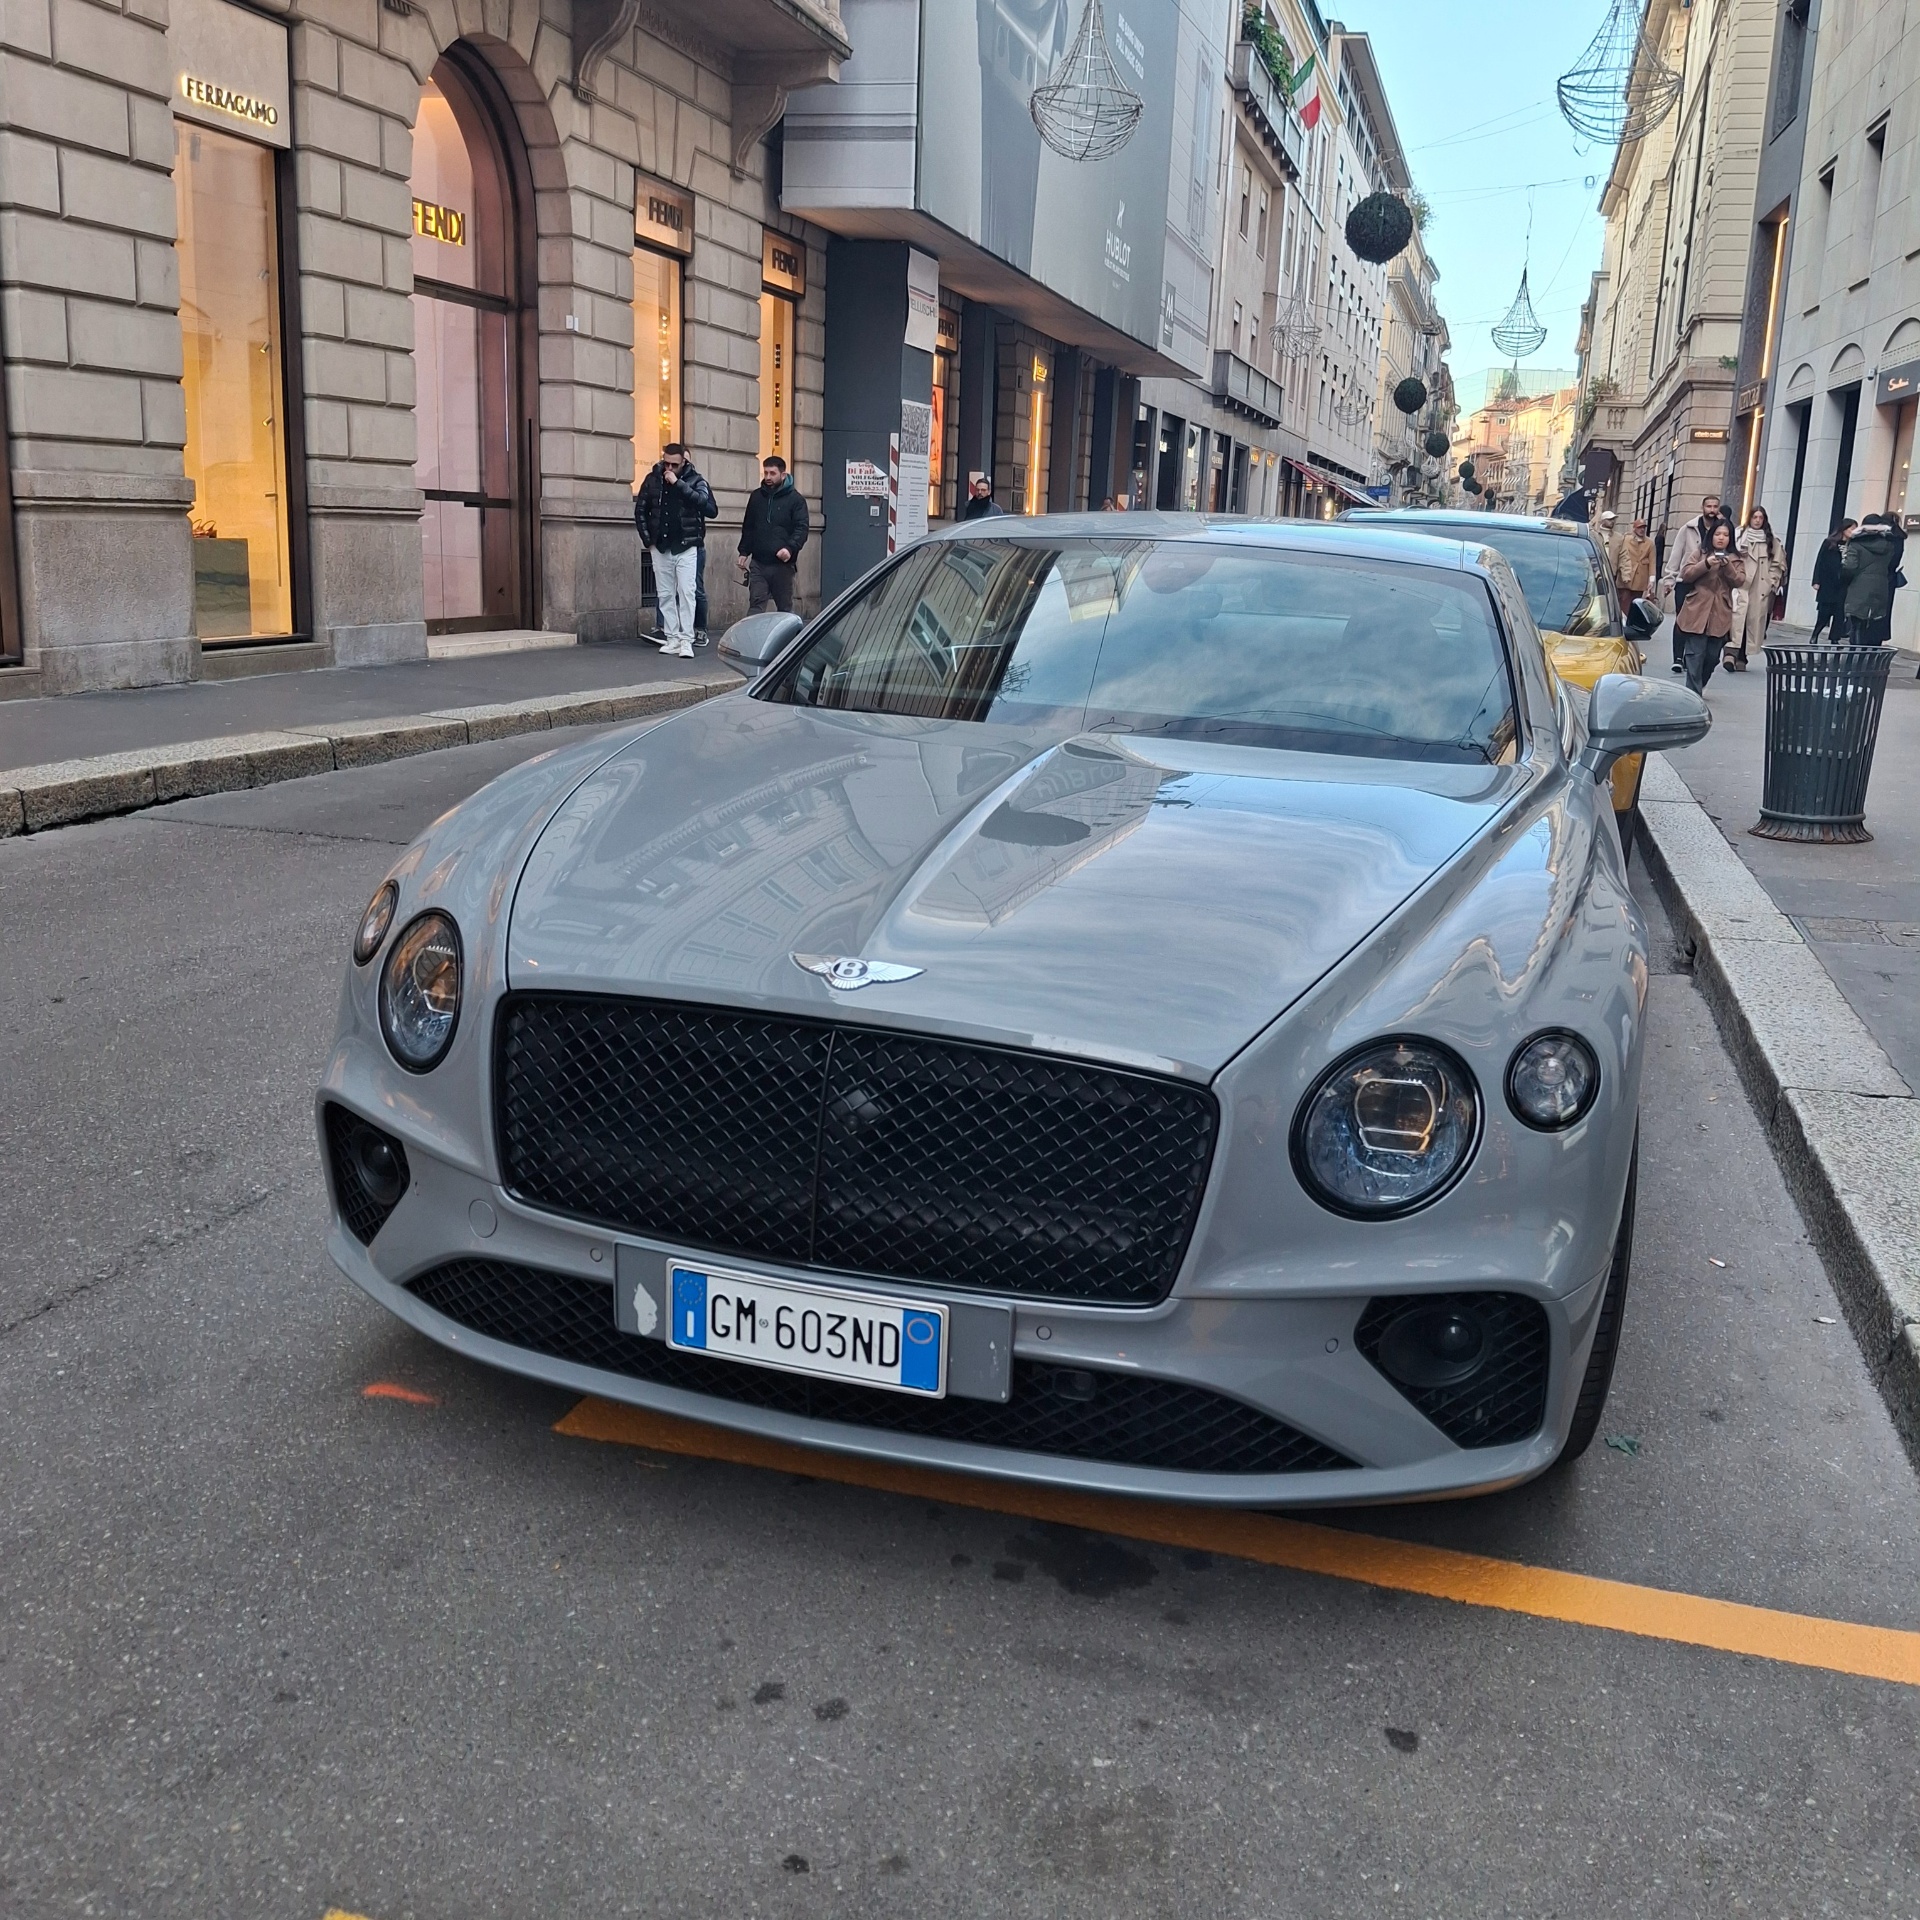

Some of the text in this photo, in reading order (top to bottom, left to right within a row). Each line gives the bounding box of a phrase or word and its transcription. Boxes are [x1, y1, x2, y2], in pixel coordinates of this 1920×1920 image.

[185, 77, 279, 125] FERRAGAMO
[411, 196, 466, 246] FENDI
[648, 196, 683, 233] FENDI
[772, 247, 799, 278] FENDI
[1104, 229, 1131, 269] HUBLOT
